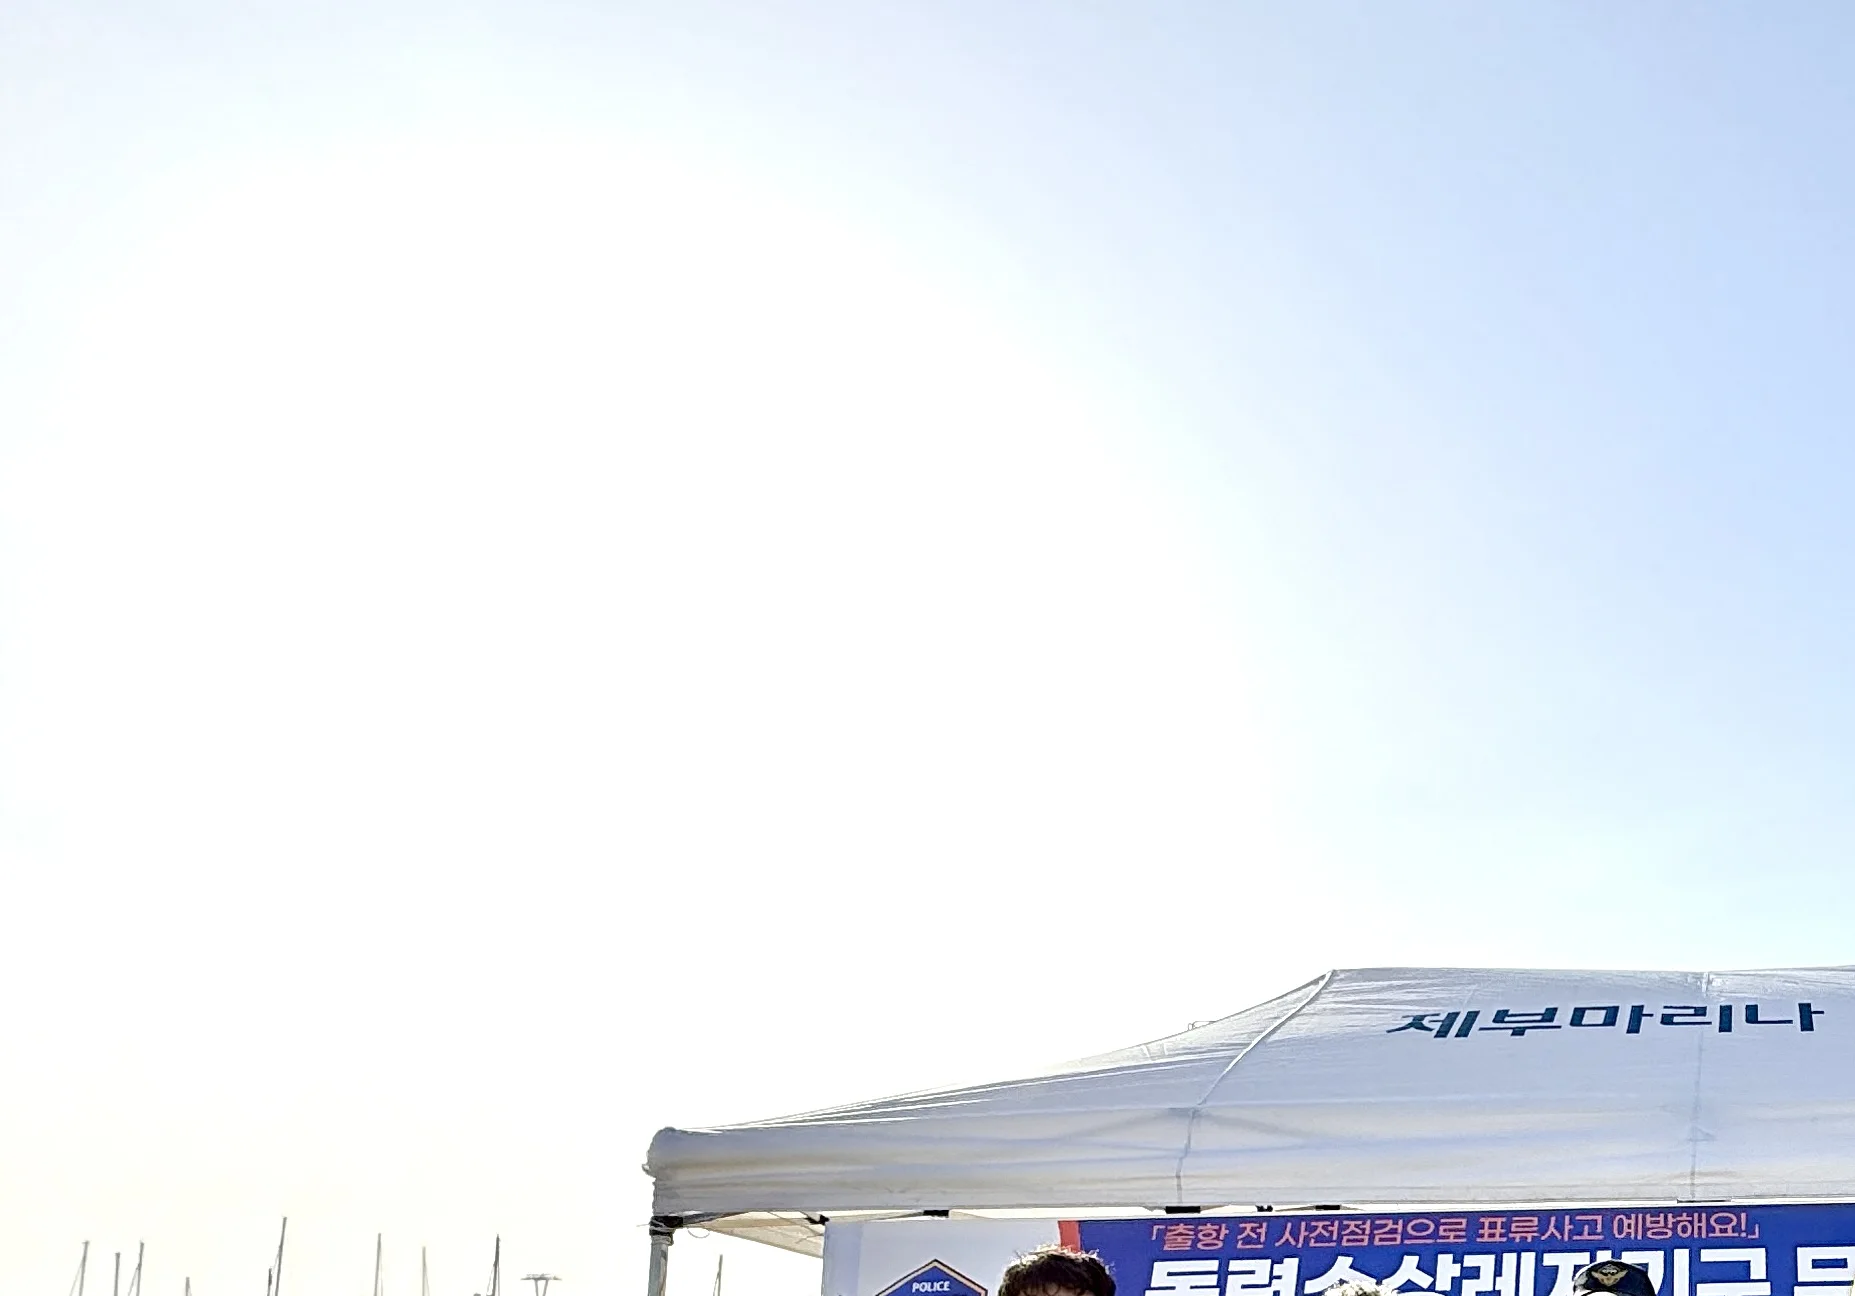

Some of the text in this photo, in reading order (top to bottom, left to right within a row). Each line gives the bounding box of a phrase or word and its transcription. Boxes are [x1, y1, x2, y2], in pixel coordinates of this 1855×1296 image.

[1386, 1001, 1825, 1039] 제부마리나
[1237, 1221, 1267, 1249] 전
[1275, 1218, 1467, 1248] 사전점검으로
[1477, 1214, 1604, 1243] 표류사고
[912, 1280, 950, 1293] POLICE
